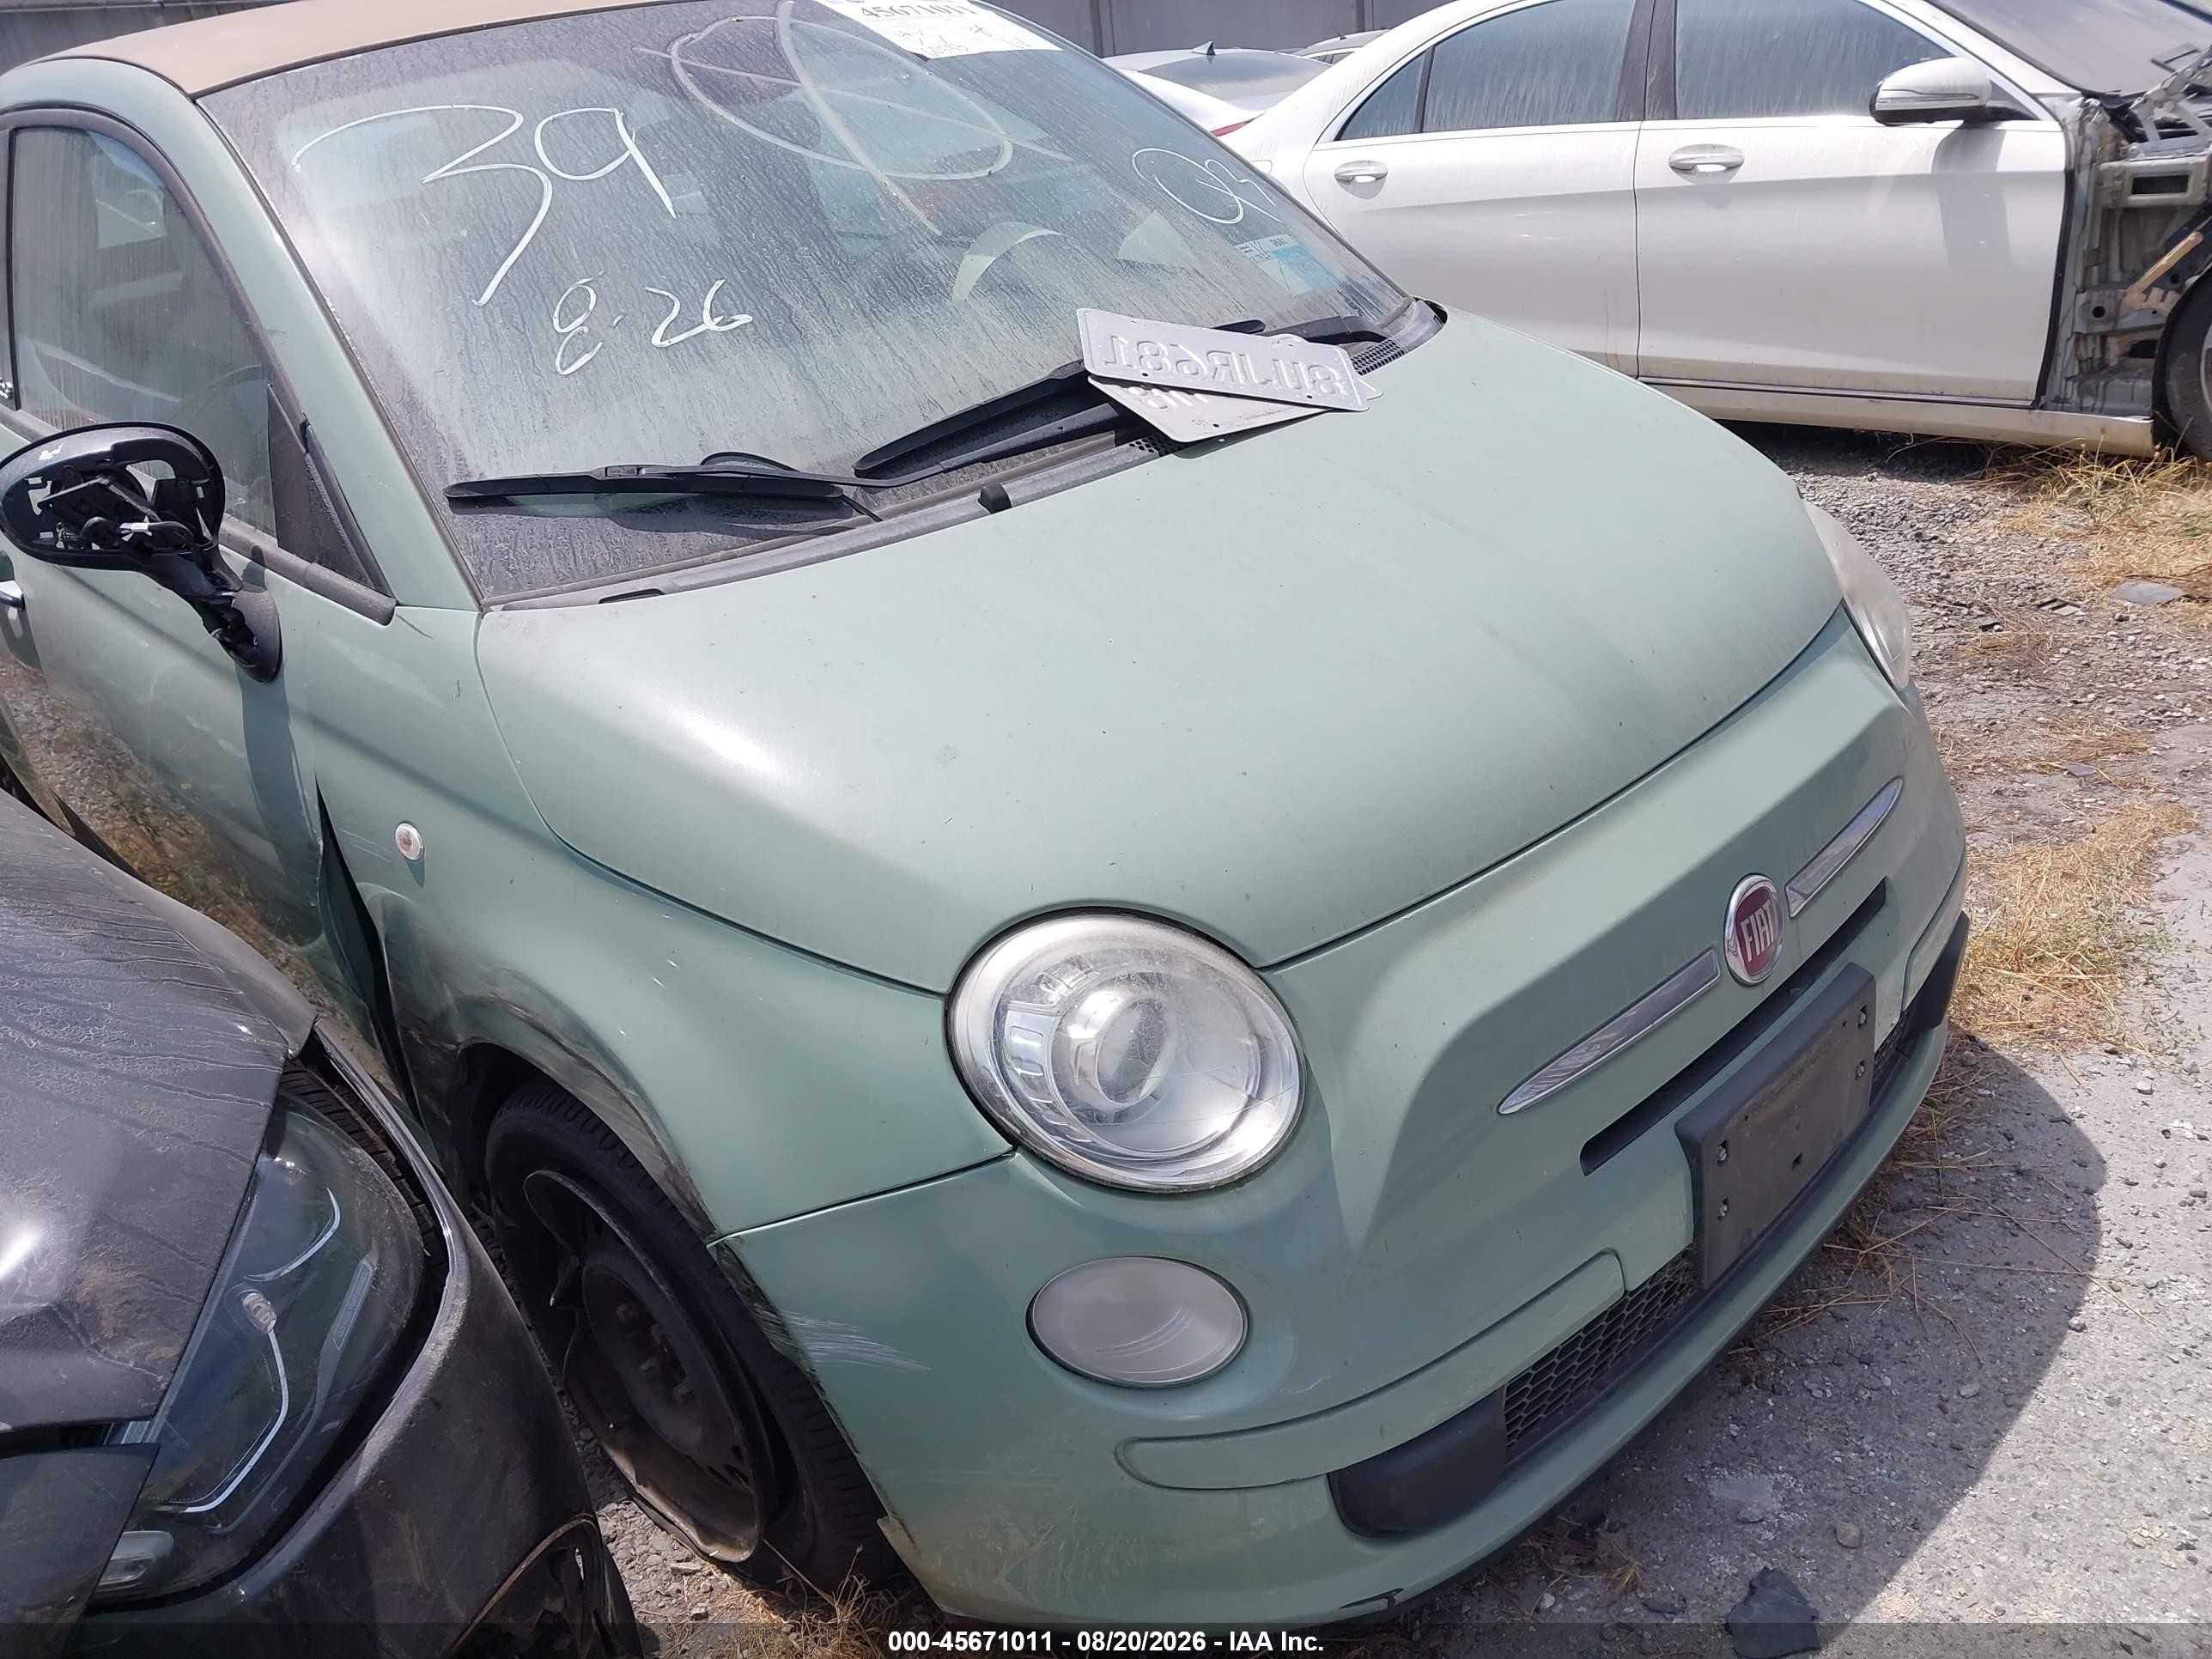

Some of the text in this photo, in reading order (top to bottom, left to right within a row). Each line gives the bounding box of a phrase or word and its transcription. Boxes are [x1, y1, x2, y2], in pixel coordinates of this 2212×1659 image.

[861, 5, 977, 17] 45671011
[290, 104, 677, 307] 39
[1740, 899, 1775, 963] FIAT
